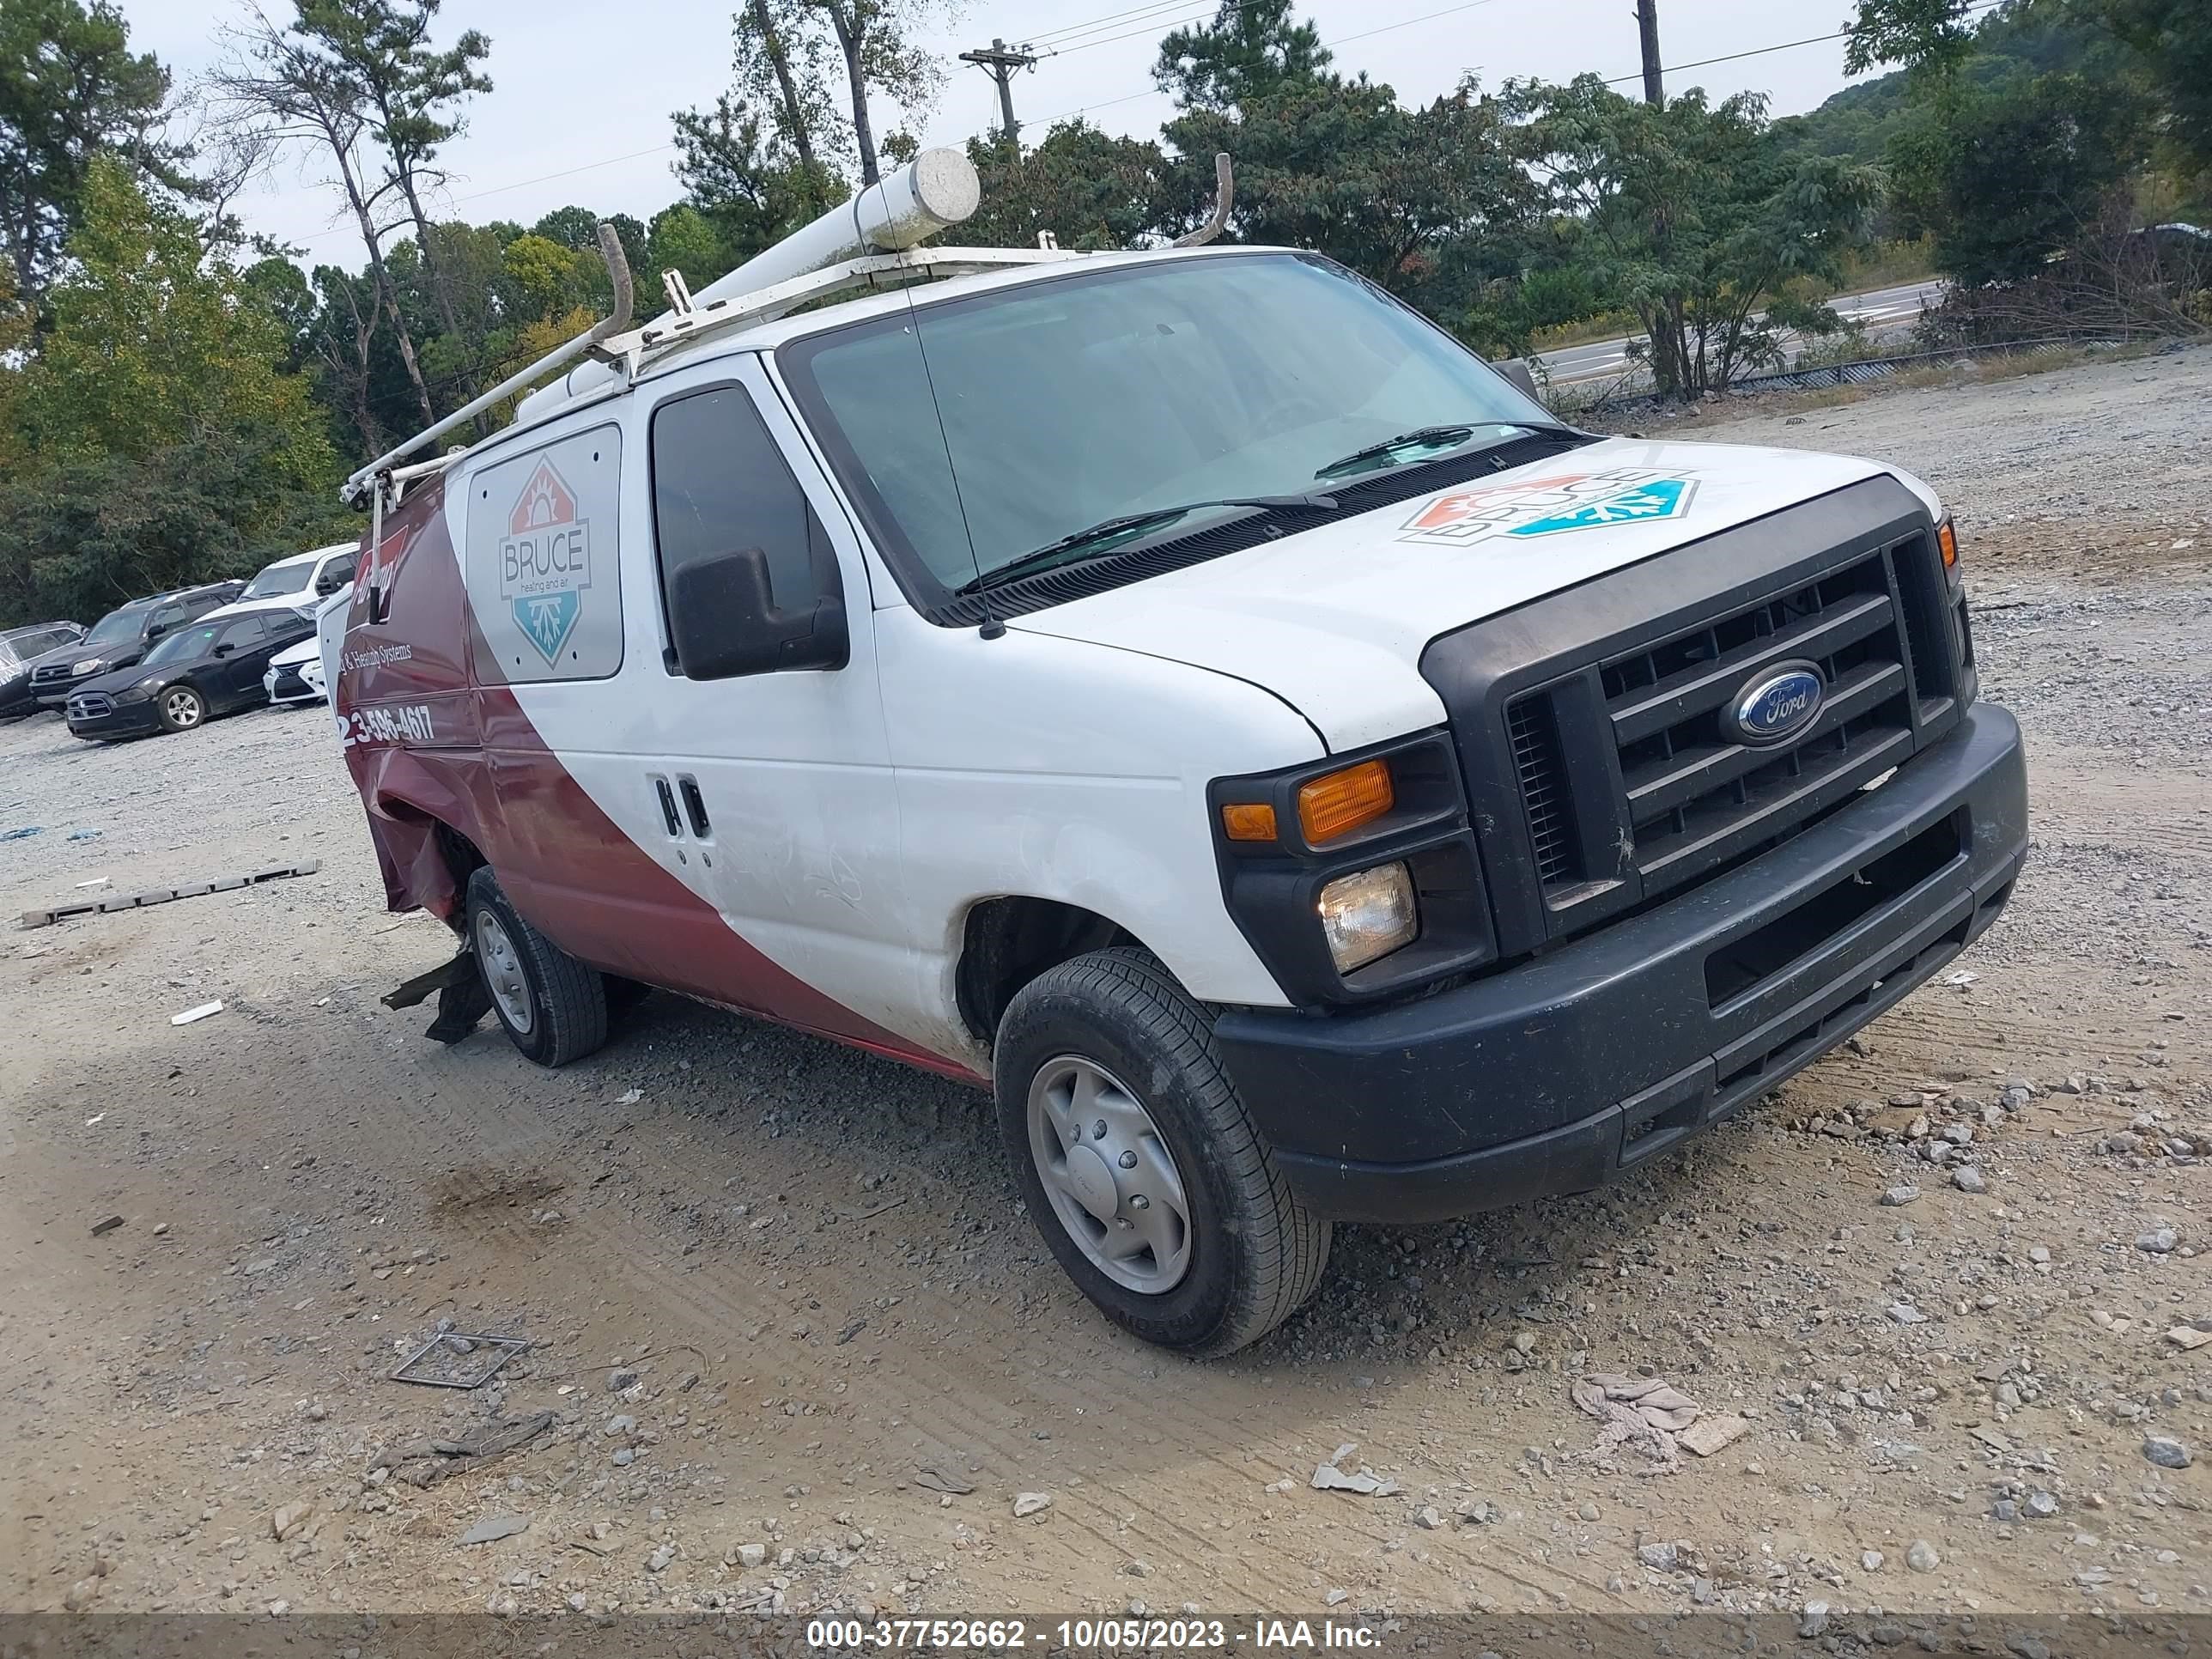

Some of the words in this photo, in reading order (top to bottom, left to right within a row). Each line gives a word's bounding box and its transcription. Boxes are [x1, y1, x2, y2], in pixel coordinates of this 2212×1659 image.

[1422, 471, 1658, 538] BRUCE
[505, 529, 583, 582] BRUCE
[521, 581, 544, 593] heating
[546, 577, 558, 589] and
[345, 653, 355, 670] &
[351, 647, 381, 669] Heating
[379, 644, 412, 667] Systems
[1765, 683, 1808, 724] Ford
